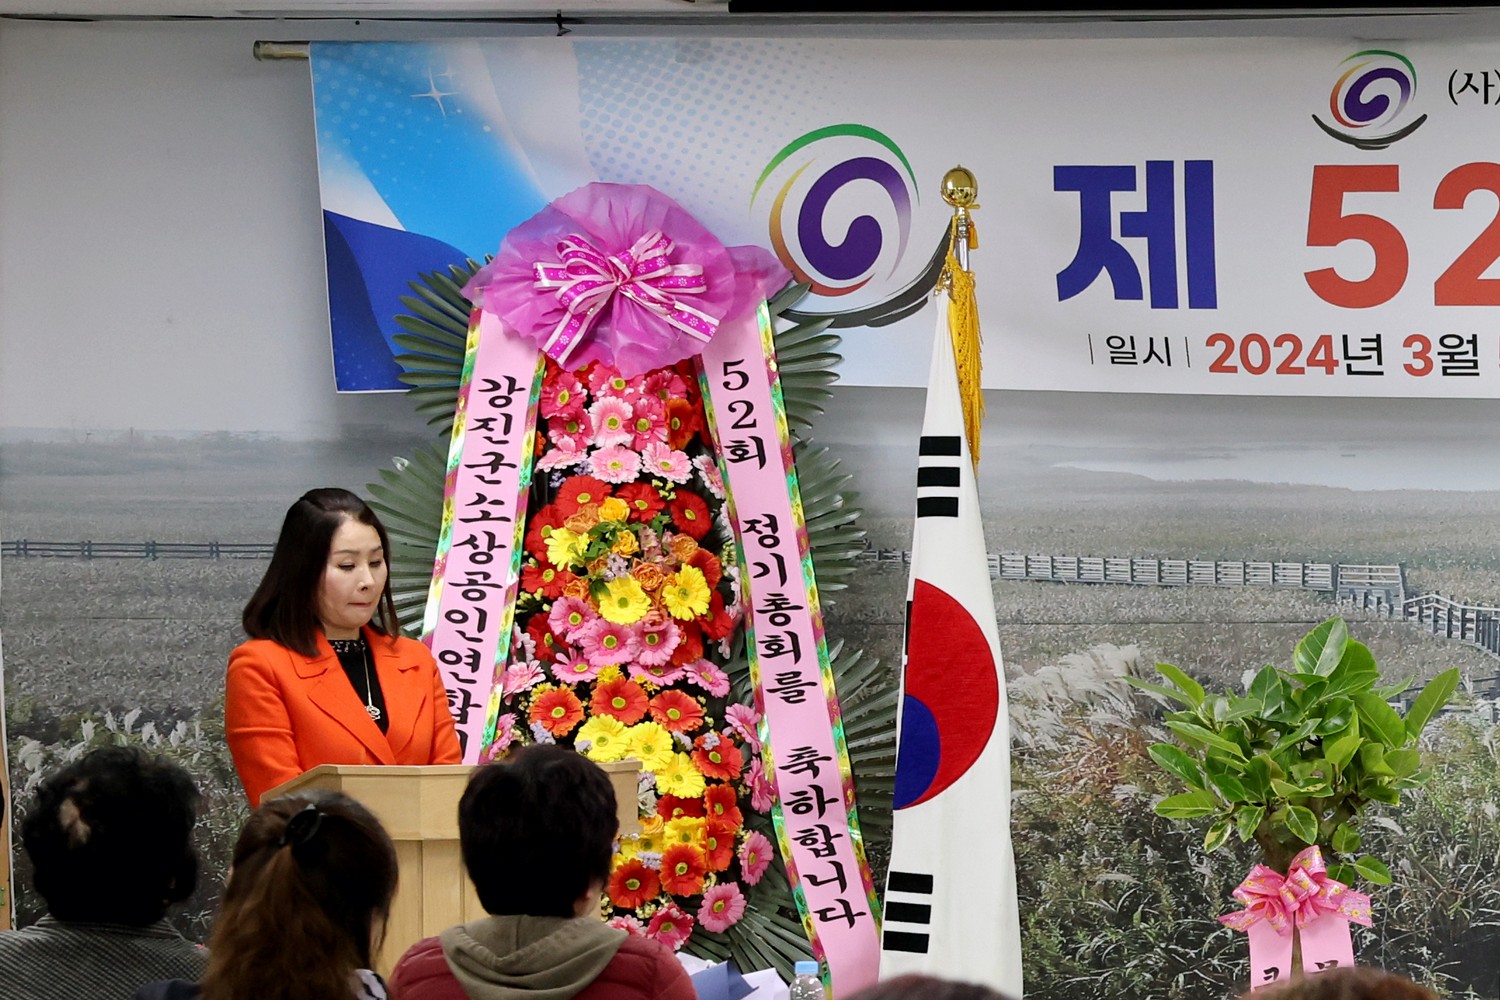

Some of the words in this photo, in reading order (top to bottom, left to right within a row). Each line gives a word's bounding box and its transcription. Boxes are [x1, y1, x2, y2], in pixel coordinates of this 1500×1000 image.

[722, 360, 767, 471] 52회
[1106, 335, 1172, 367] 일시
[1205, 332, 1385, 376] 2024년
[1402, 333, 1480, 377] 3월
[742, 513, 818, 706] 정기총회를
[780, 745, 868, 929] 축하합니다
